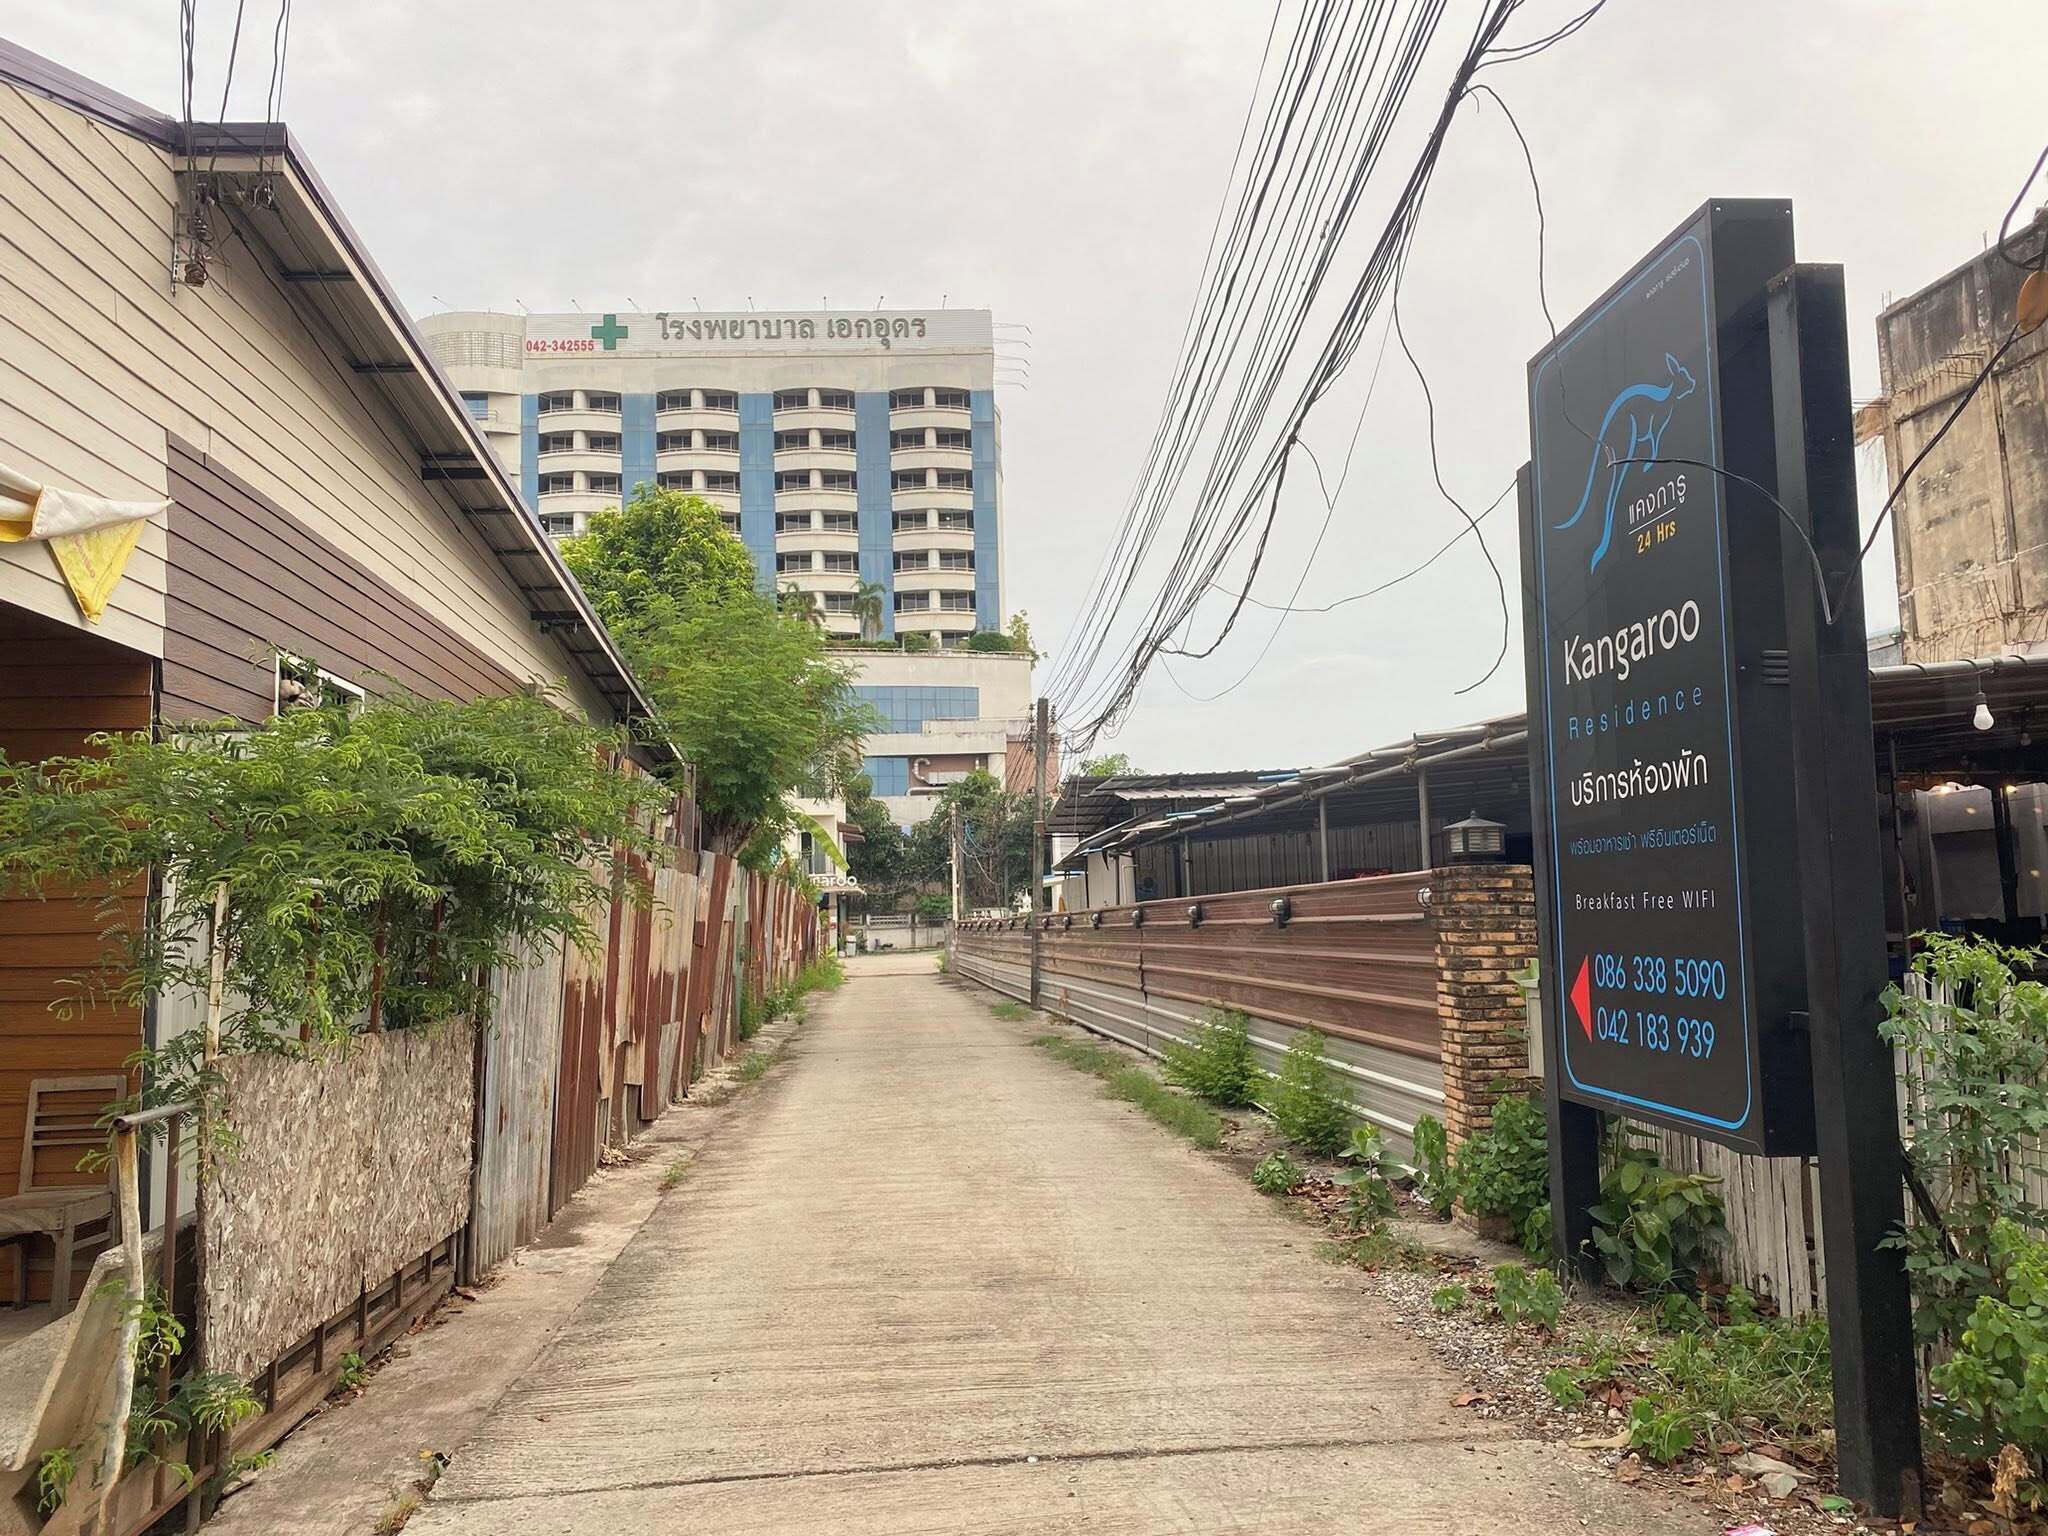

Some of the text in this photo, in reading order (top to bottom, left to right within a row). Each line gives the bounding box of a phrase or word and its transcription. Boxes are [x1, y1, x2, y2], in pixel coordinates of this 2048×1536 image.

[526, 340, 594, 352] 042-342555
[656, 313, 927, 348] โรงพยาบาล เอกอุดร
[1628, 474, 1687, 525] แคงการู
[1637, 519, 1676, 554] 24 Hrs
[1564, 600, 1700, 685] Kangaroo
[1569, 687, 1702, 740] Residence
[1571, 749, 1708, 806] บริการห้องพัก
[1576, 889, 1716, 910] Breakfast Free WIFI
[1594, 953, 1726, 1000] 086 338 5090
[1597, 1006, 1715, 1059] 042 183 939
